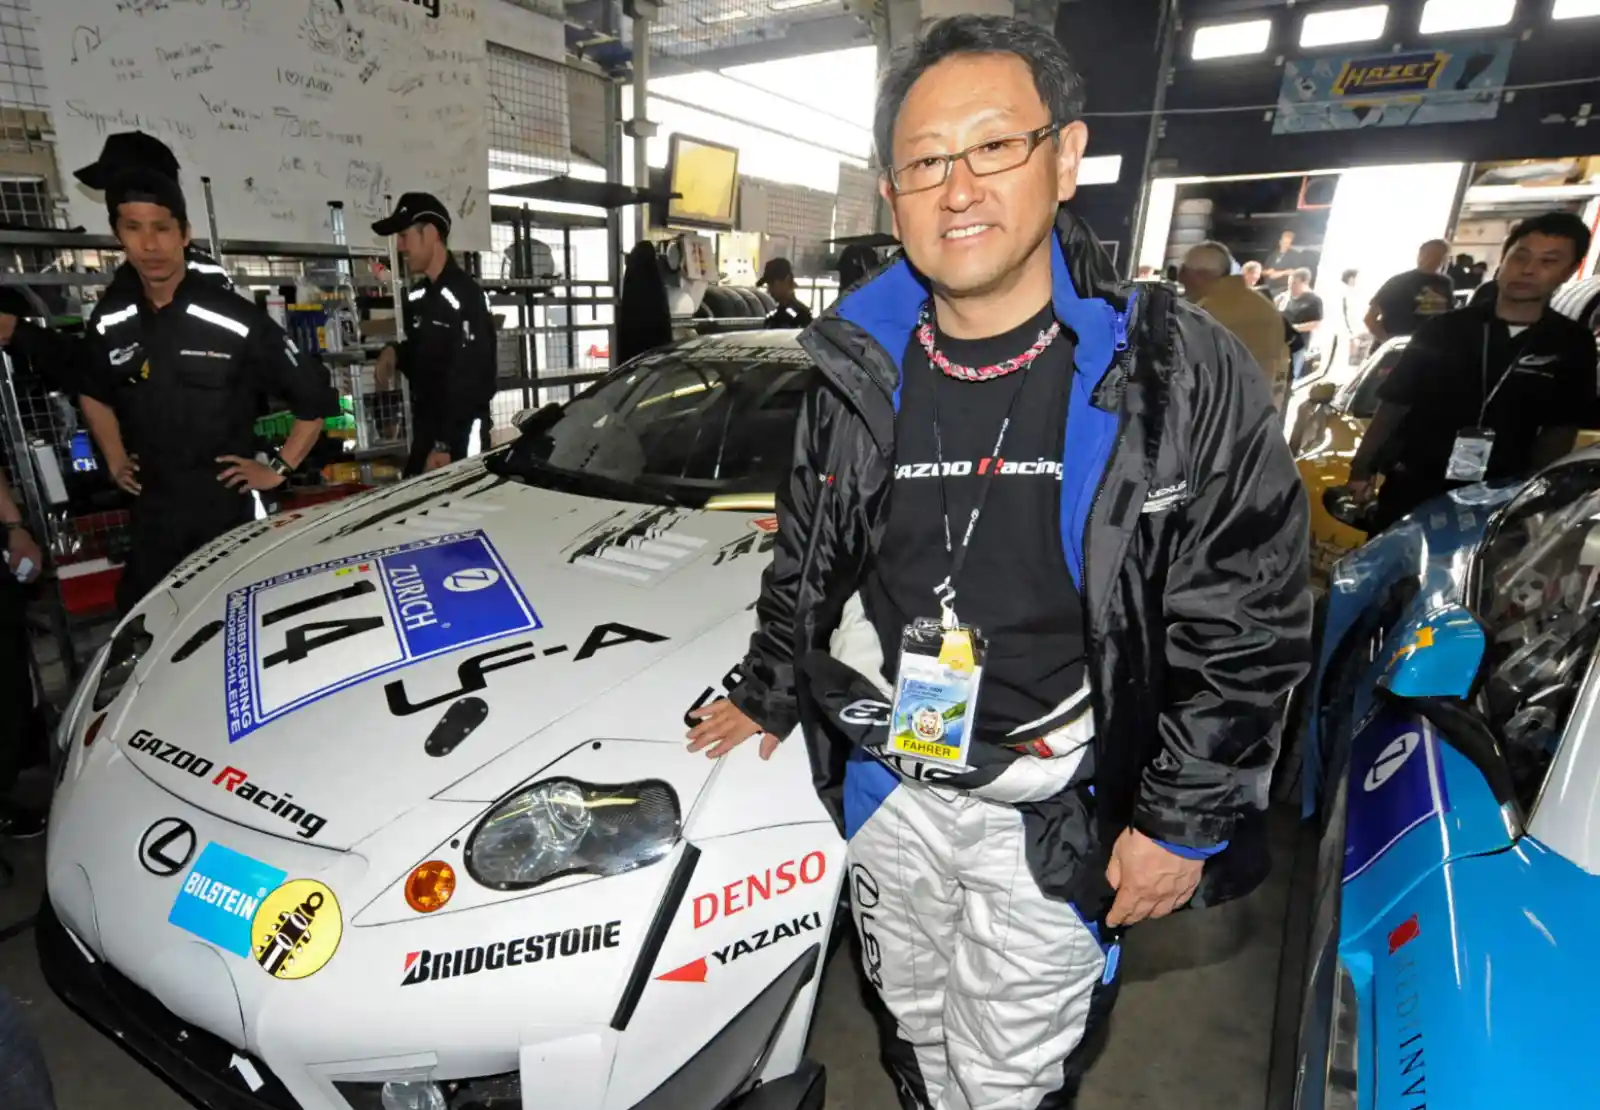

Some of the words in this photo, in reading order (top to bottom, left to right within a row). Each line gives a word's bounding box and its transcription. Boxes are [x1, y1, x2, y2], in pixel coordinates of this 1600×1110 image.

[1343, 62, 1438, 88] HAZET
[261, 579, 386, 671] 14
[388, 564, 438, 630] ZURICH
[227, 607, 242, 735] NORDSCHLEIFE
[903, 739, 952, 757] FAHRER
[128, 729, 214, 778] GAZOO
[212, 765, 328, 839] Racing
[184, 871, 260, 921] BILSTEIN
[692, 850, 827, 929] DENSO
[400, 920, 622, 987] BRIDGESTONE
[711, 911, 822, 966] YAZAKI
